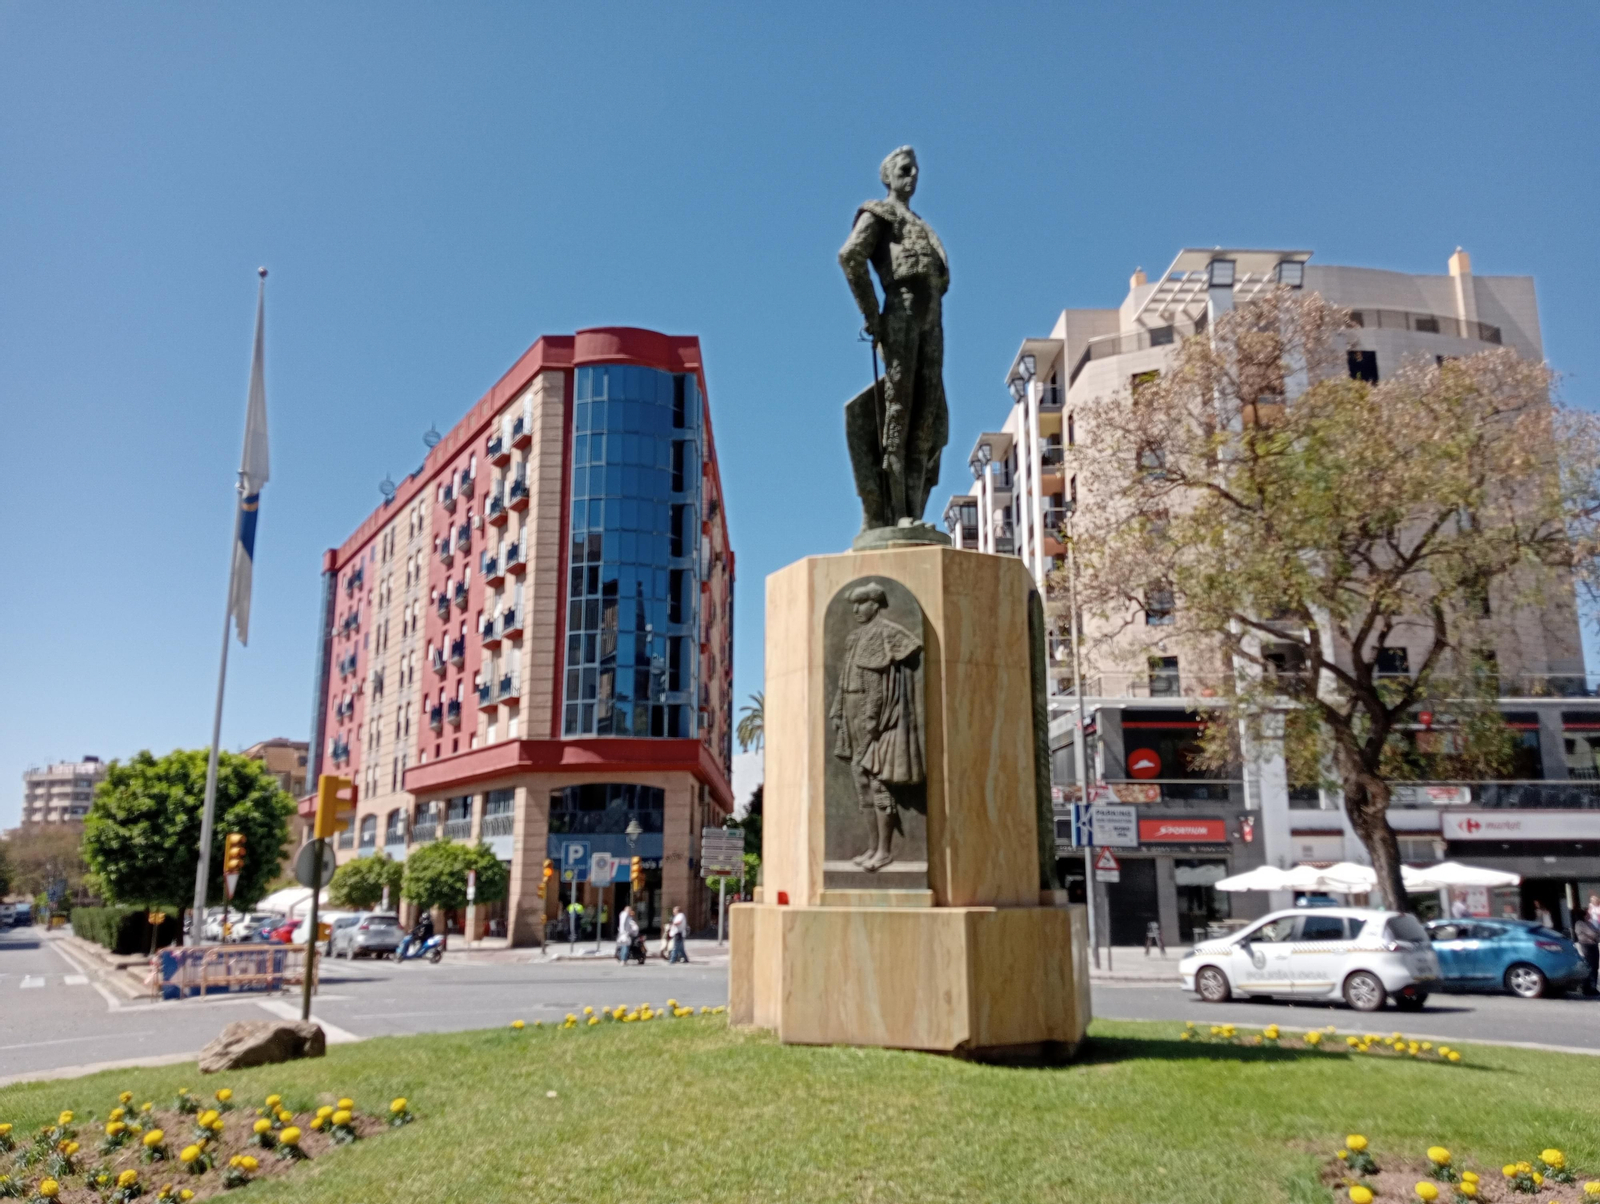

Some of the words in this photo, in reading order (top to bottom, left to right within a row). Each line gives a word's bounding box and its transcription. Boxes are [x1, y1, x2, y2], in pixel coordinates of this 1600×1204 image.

[1095, 809, 1133, 817] PARKING
[1154, 825, 1208, 837] SPORTIUM
[1484, 821, 1522, 831] market
[568, 845, 585, 865] P
[1290, 971, 1331, 980] LOCAL
